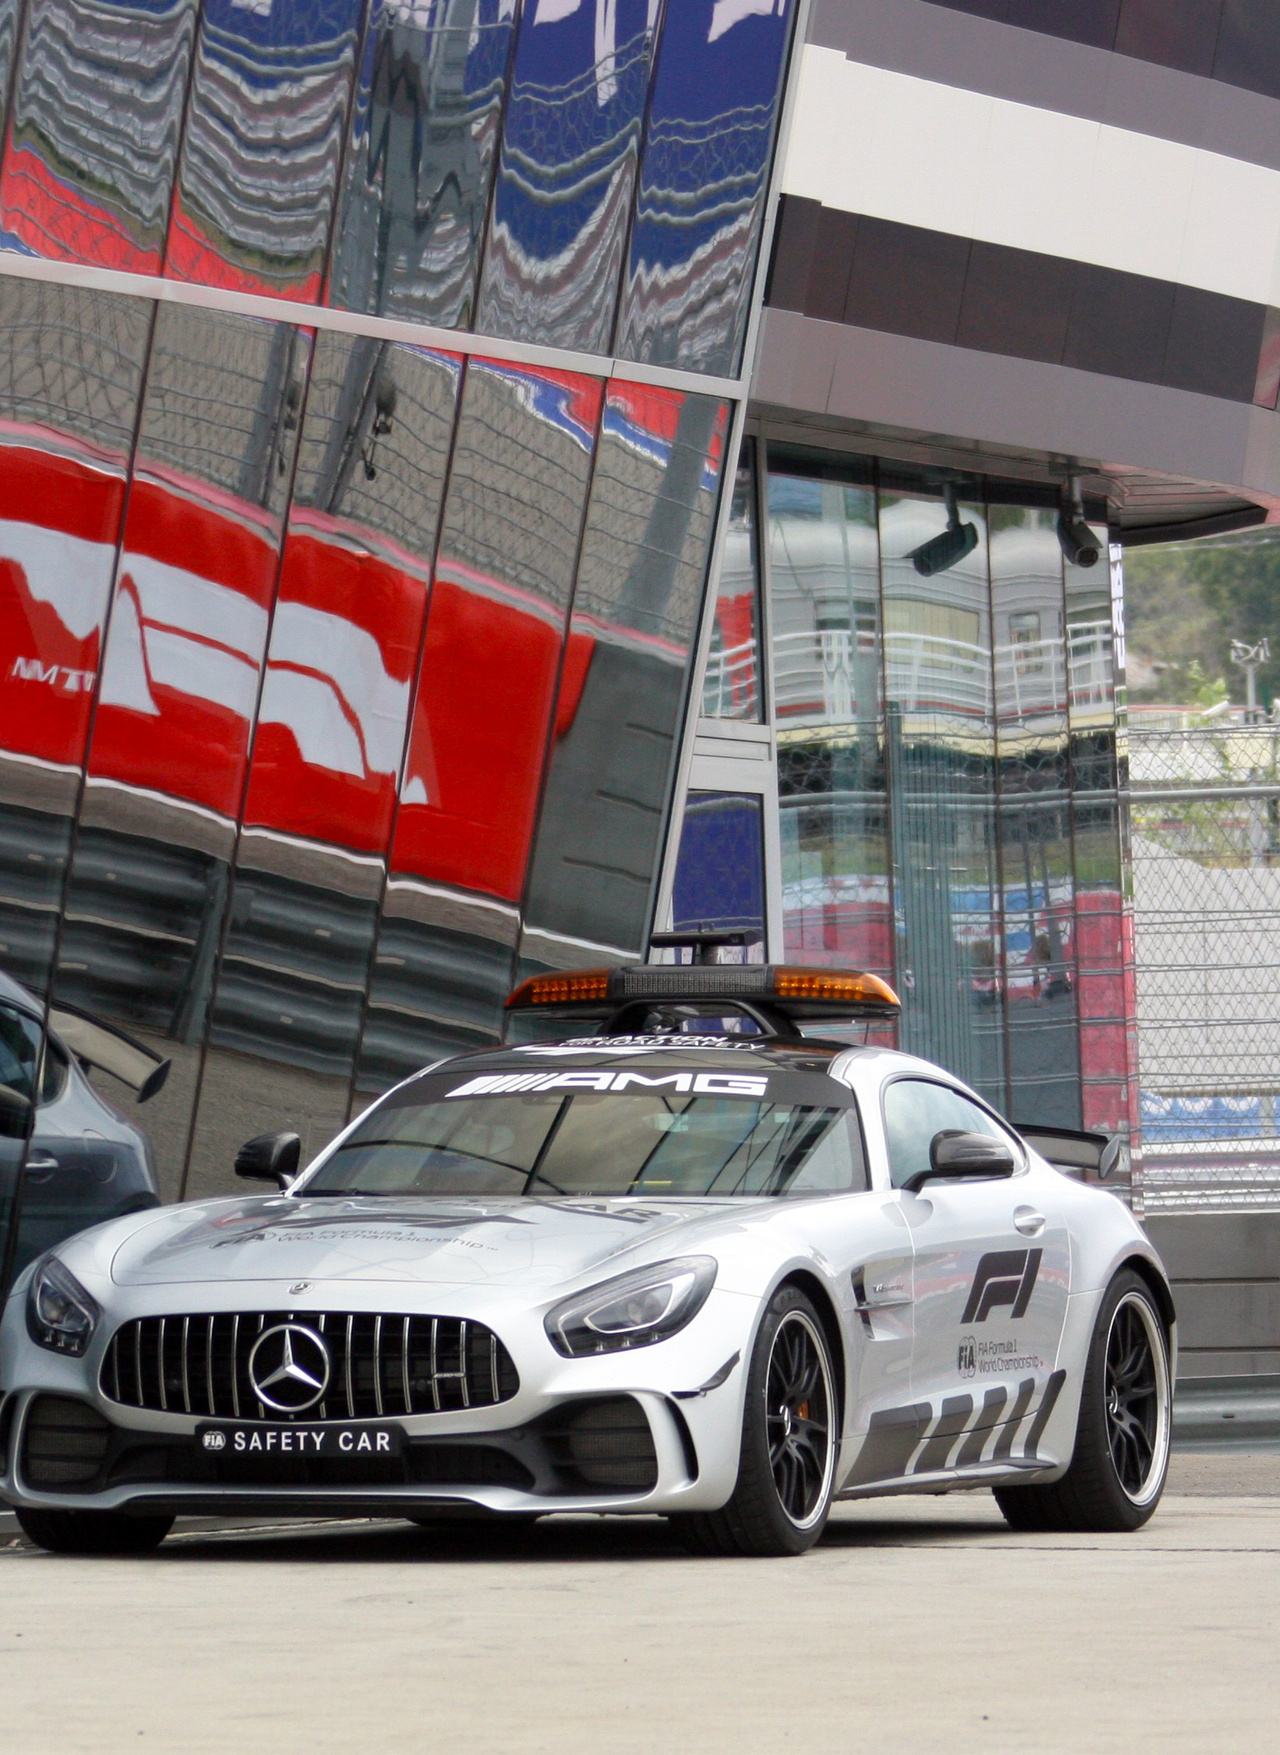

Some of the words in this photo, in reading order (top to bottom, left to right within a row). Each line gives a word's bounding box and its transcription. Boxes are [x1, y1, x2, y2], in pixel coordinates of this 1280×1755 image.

[533, 1073, 769, 1097] AMG
[278, 1233, 334, 1242] World
[979, 1358, 997, 1373] World
[234, 1431, 325, 1450] SAFETY
[339, 1431, 390, 1450] CAR
